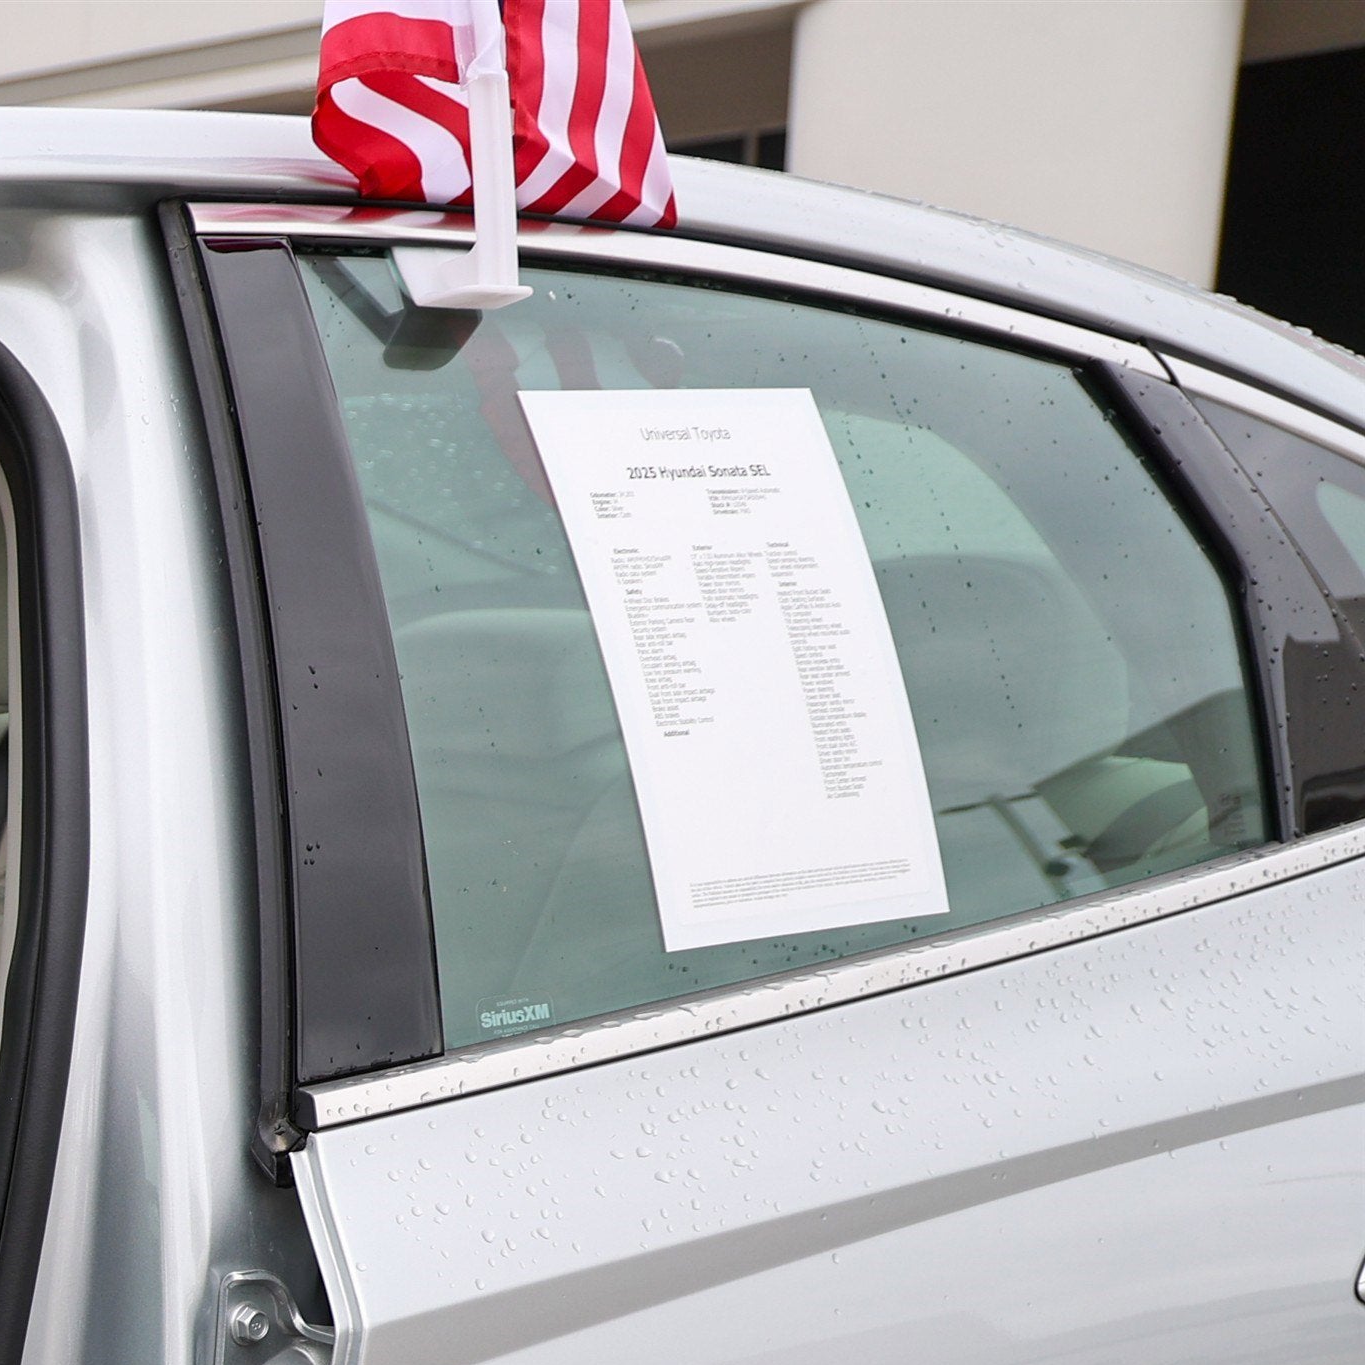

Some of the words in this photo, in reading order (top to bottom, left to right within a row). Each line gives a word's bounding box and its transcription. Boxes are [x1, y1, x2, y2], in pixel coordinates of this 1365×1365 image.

[641, 427, 691, 440] Universal
[694, 427, 731, 441] Toyota
[627, 467, 656, 479] 2025
[660, 466, 707, 481] Hyundai
[708, 465, 747, 477] Sonata
[750, 464, 770, 476] SEL
[480, 1003, 550, 1028] SiriusXM
